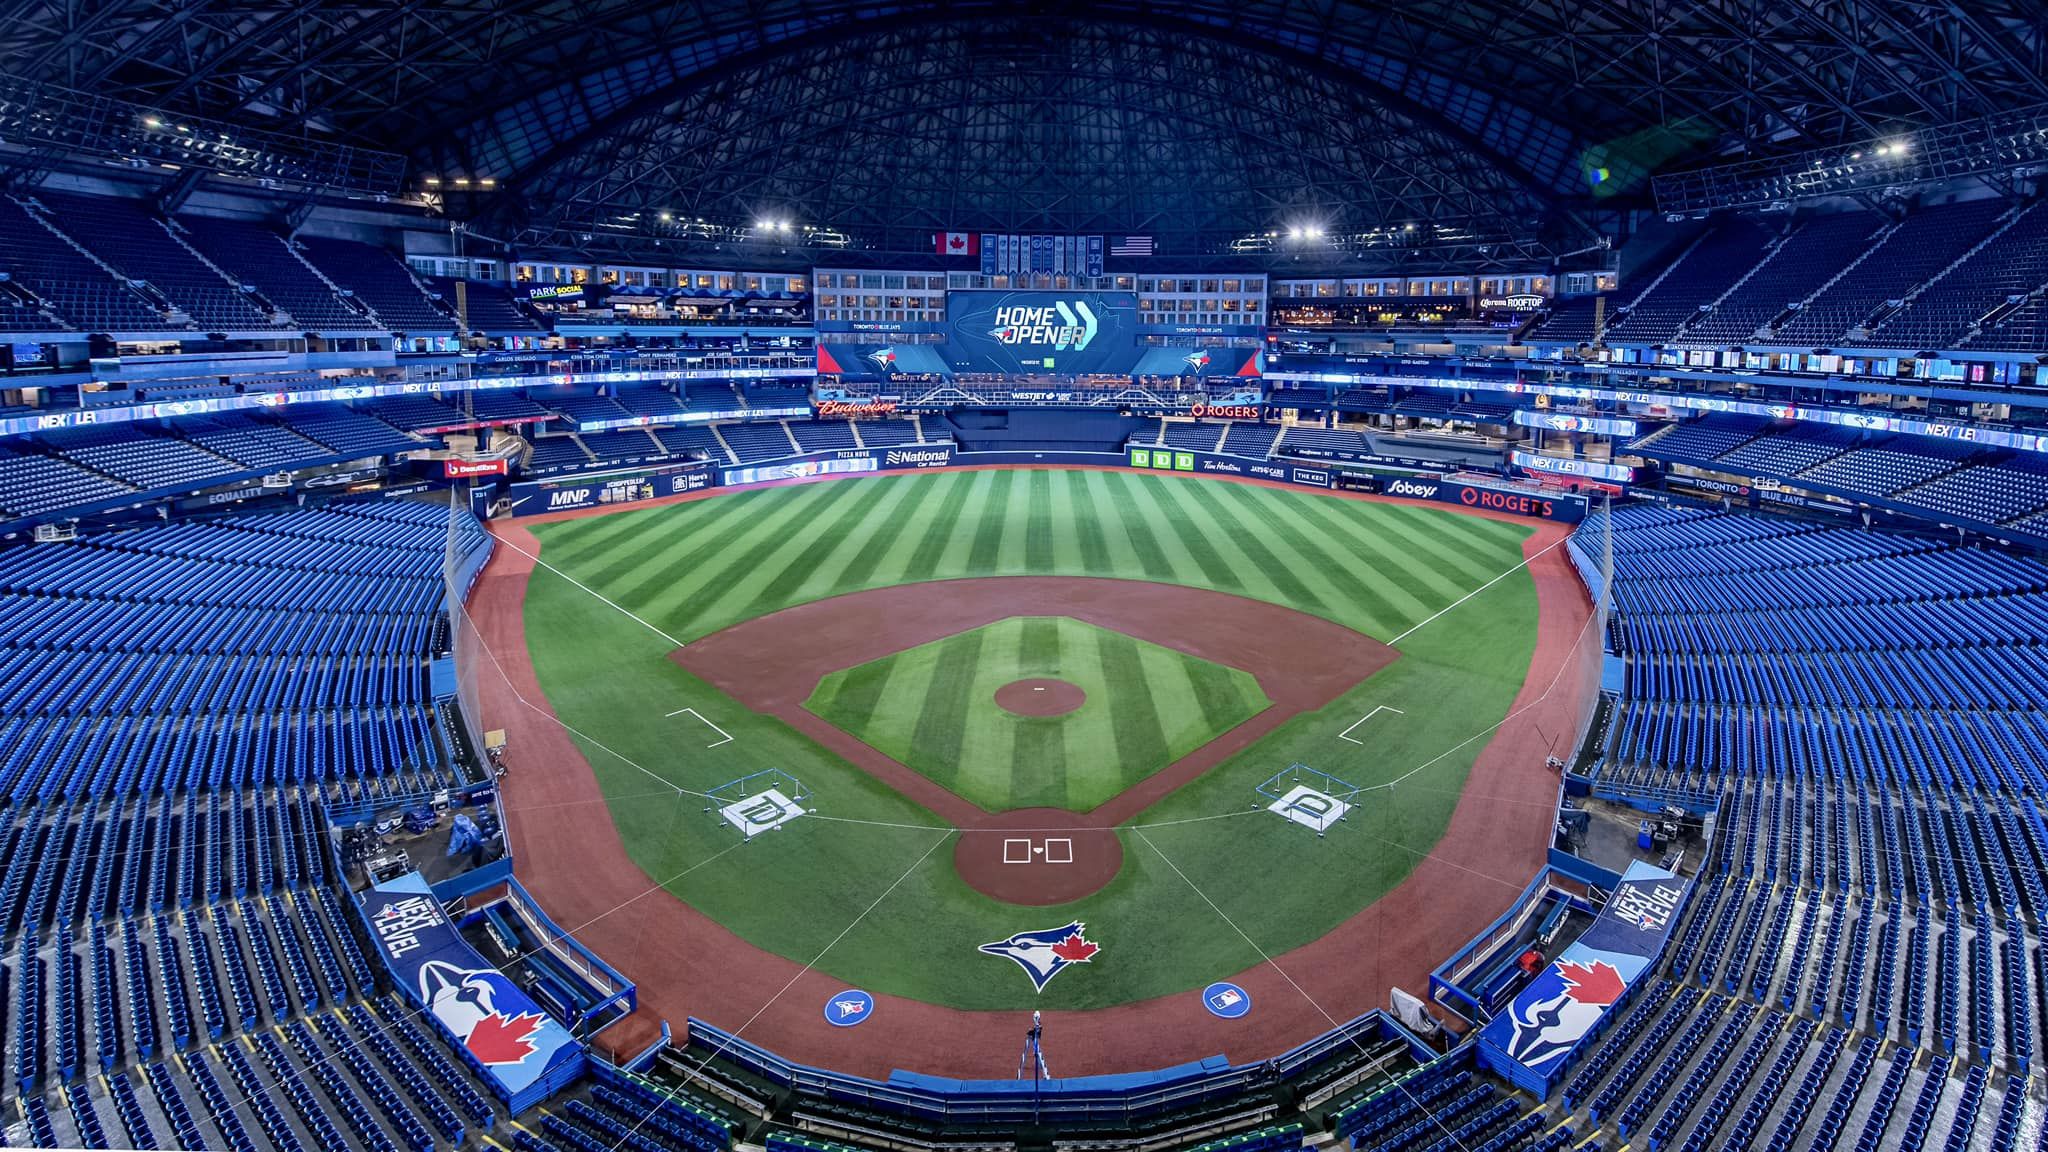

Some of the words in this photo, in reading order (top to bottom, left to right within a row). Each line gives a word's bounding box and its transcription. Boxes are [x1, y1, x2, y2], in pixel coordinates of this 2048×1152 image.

[1088, 254, 1101, 264] 32
[530, 286, 557, 298] PARK
[556, 285, 583, 294] SOCIAL
[1480, 299, 1506, 308] Corona
[1507, 298, 1543, 307] ROOFTOP
[995, 307, 1056, 326] HOME
[1004, 326, 1086, 345] OPENER
[890, 373, 921, 381] WESTJET
[1011, 392, 1046, 401] WESTJET
[816, 400, 896, 414] Budweiser
[1207, 406, 1258, 417] ROGERS
[837, 451, 853, 459] PIZZA
[1133, 451, 1147, 464] TD
[1156, 452, 1170, 466] TD
[1178, 454, 1192, 468] TD
[1203, 460, 1216, 469] Tim
[1216, 461, 1241, 472] Hortons
[688, 473, 708, 481] Here's
[1388, 480, 1438, 498] Sobeys
[1695, 478, 1739, 493] TORONTO
[209, 487, 263, 504] EQUALITY
[551, 489, 590, 505] MNP
[1761, 491, 1782, 501] BLUE
[1782, 495, 1804, 506] JAYS
[1614, 886, 1652, 924] NEXT
[1640, 885, 1682, 926] LEVEL
[395, 897, 437, 931] NEXT
[375, 914, 420, 959] LEVEL
